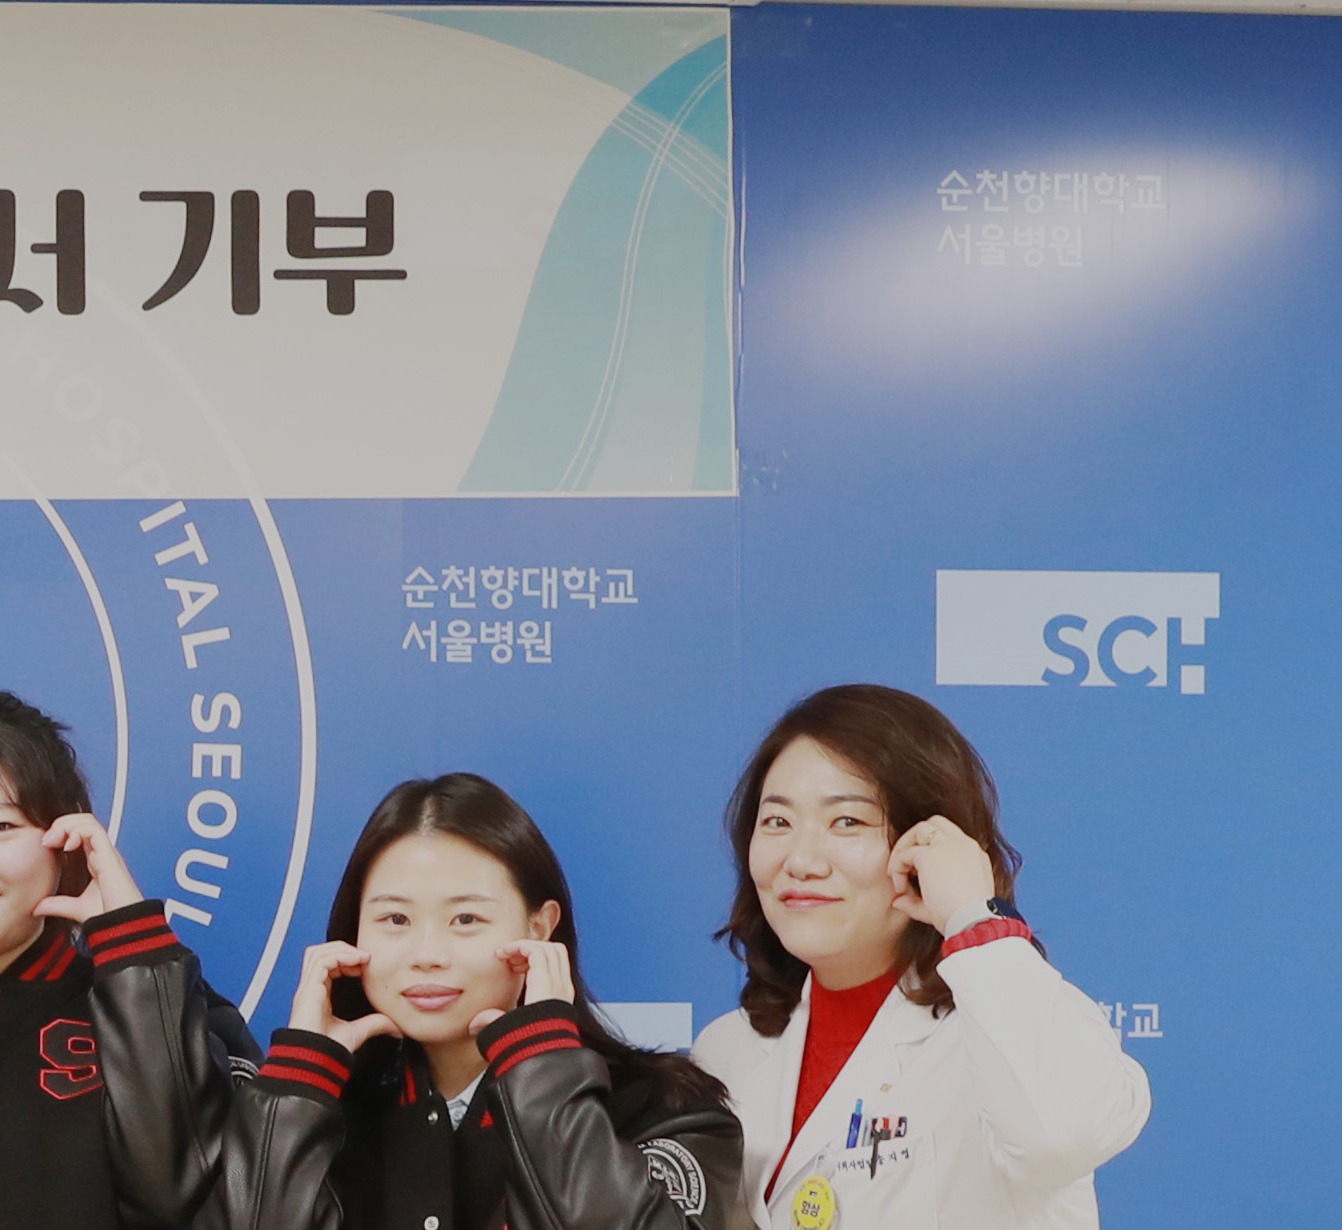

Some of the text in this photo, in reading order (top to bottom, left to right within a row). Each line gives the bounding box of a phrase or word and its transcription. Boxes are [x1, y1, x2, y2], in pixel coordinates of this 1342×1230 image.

[936, 169, 1168, 213] 순천향대학교
[139, 189, 408, 316] 기부
[936, 223, 1085, 268] 서울병원
[401, 565, 639, 610] 순천향대학교
[401, 619, 554, 665] 서울병원
[163, 691, 243, 927] SEOUL
